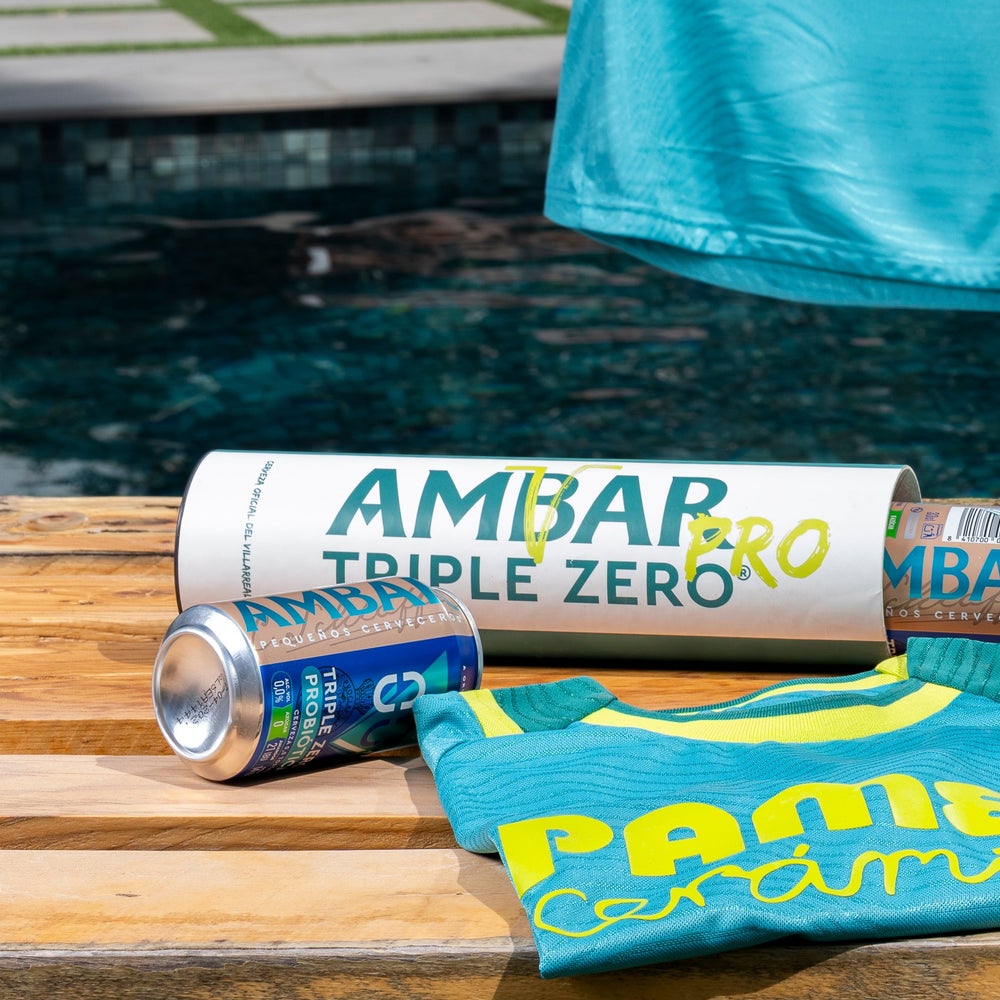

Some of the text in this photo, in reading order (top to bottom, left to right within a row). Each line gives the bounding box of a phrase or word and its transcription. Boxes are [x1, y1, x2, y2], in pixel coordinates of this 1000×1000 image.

[241, 460, 275, 598] CERVEZA OFICIAL DEL VILLARREAL
[325, 467, 736, 549] AMBAR
[684, 512, 832, 590] PRO
[260, 628, 351, 650] PEQUEÑOS
[273, 680, 285, 703] 0,0%
[318, 667, 337, 736] TRIPLE
[286, 709, 300, 746] CERVEZA
